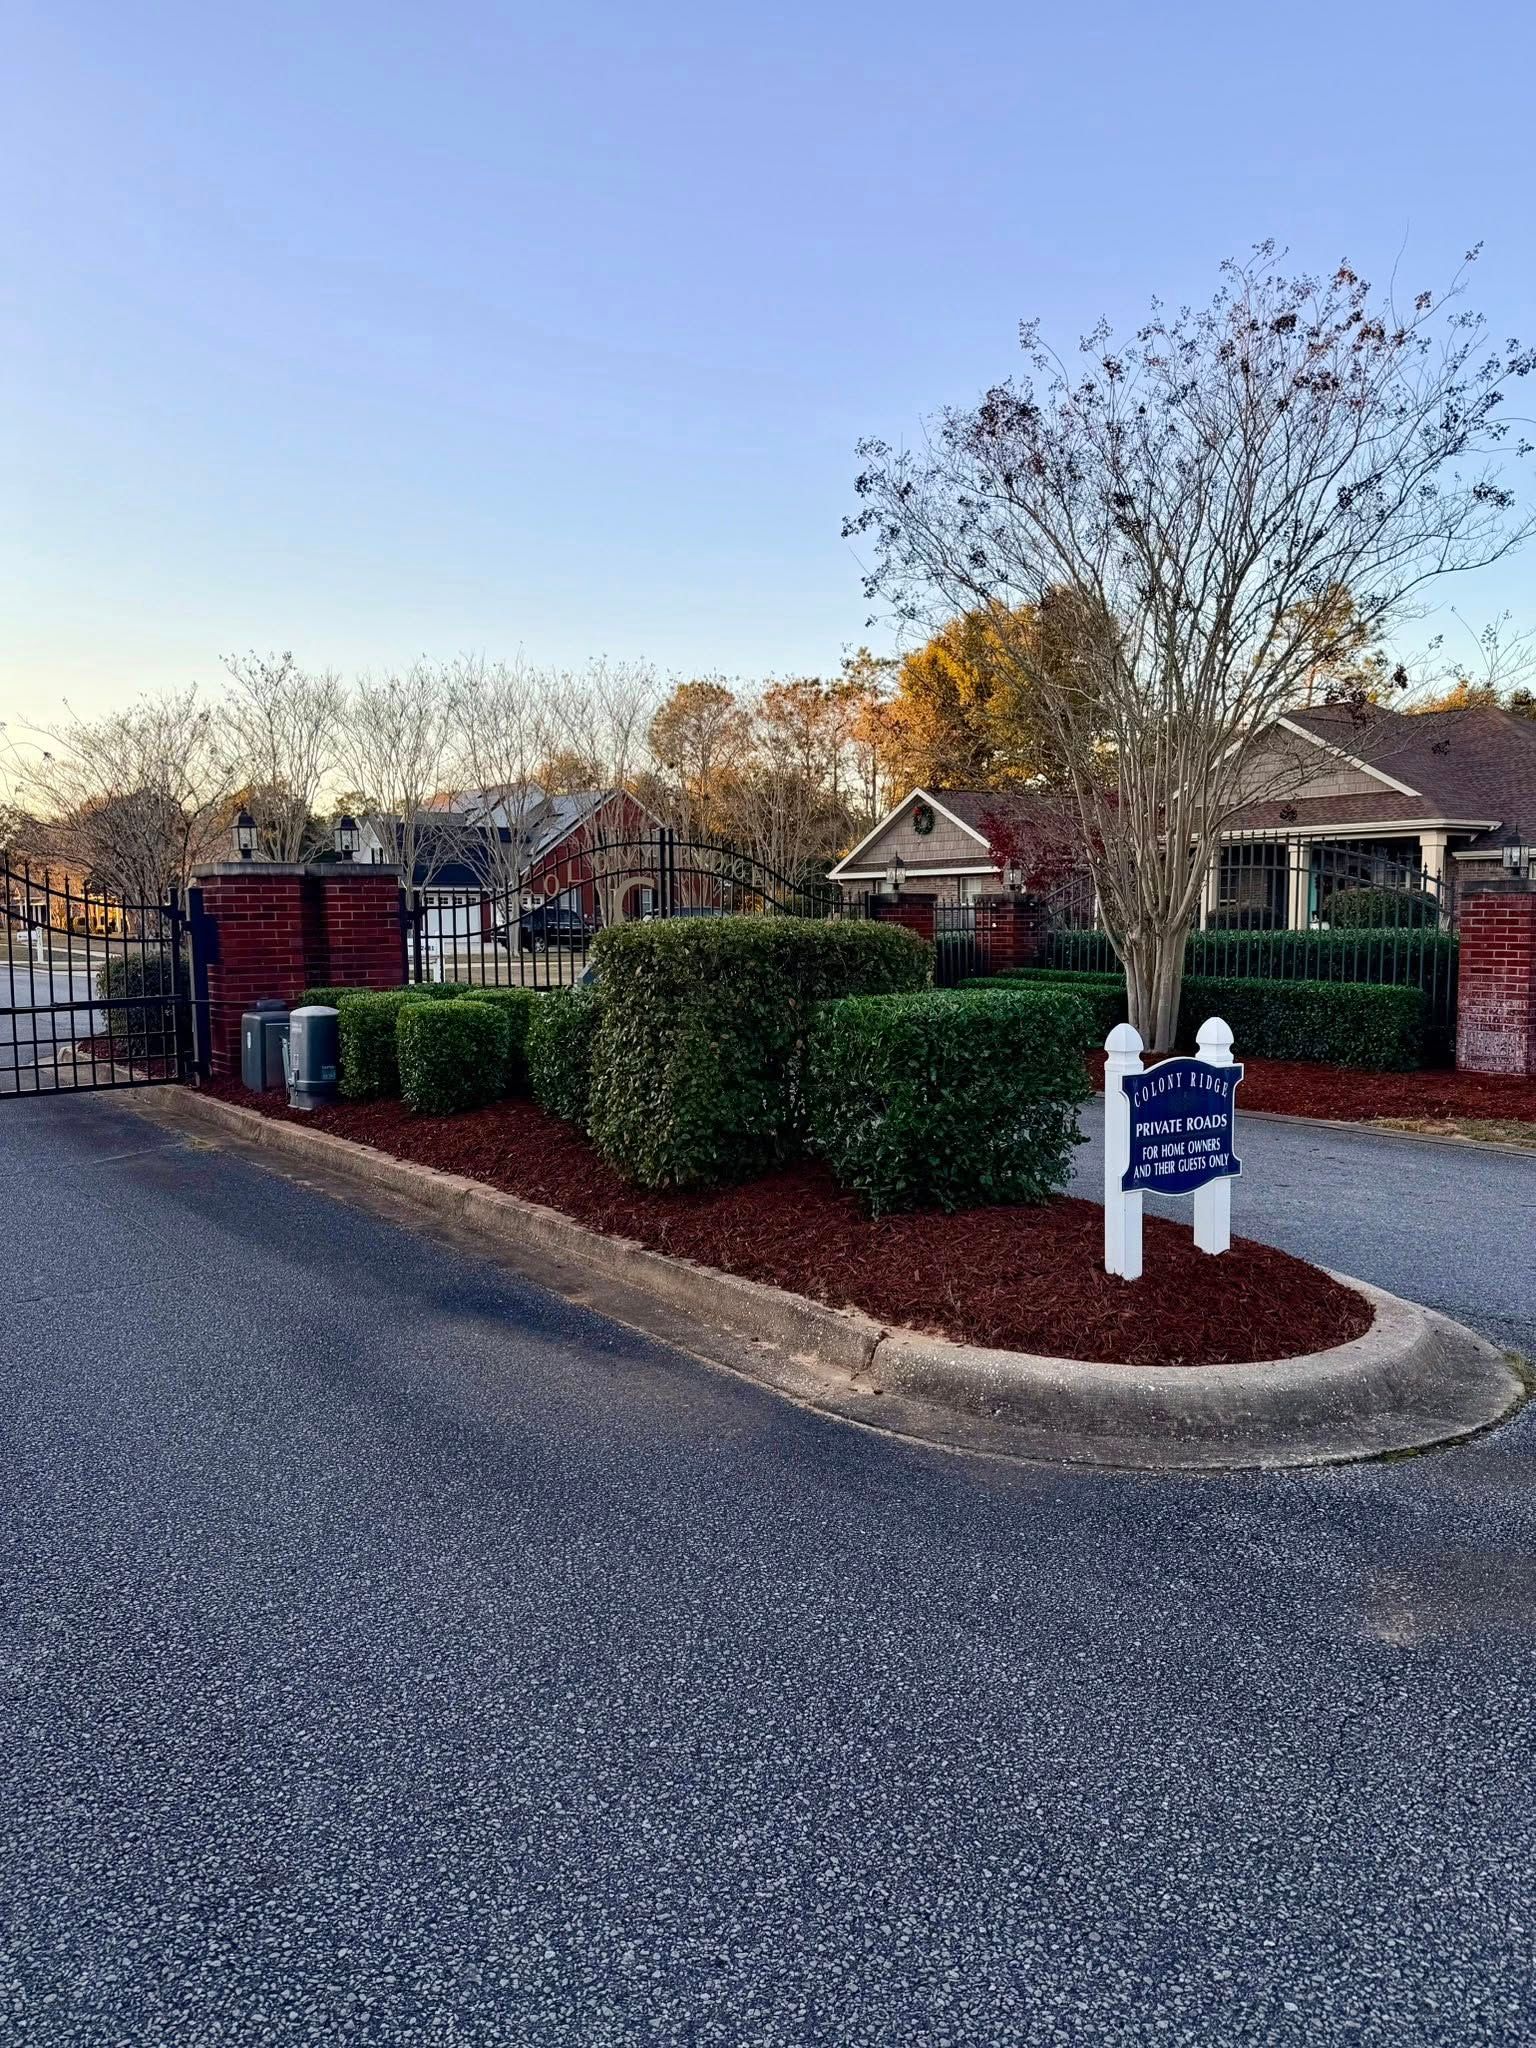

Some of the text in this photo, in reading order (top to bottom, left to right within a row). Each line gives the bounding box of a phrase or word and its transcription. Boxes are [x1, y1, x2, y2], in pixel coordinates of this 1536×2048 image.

[1134, 1072, 1228, 1108] COLONY RIDGE
[1136, 1114, 1227, 1137] PRIVATE ROADS
[1143, 1138, 1220, 1160] FOR HOME OWNERS
[1134, 1153, 1229, 1179] AND THEIR GUESTS ONLY
